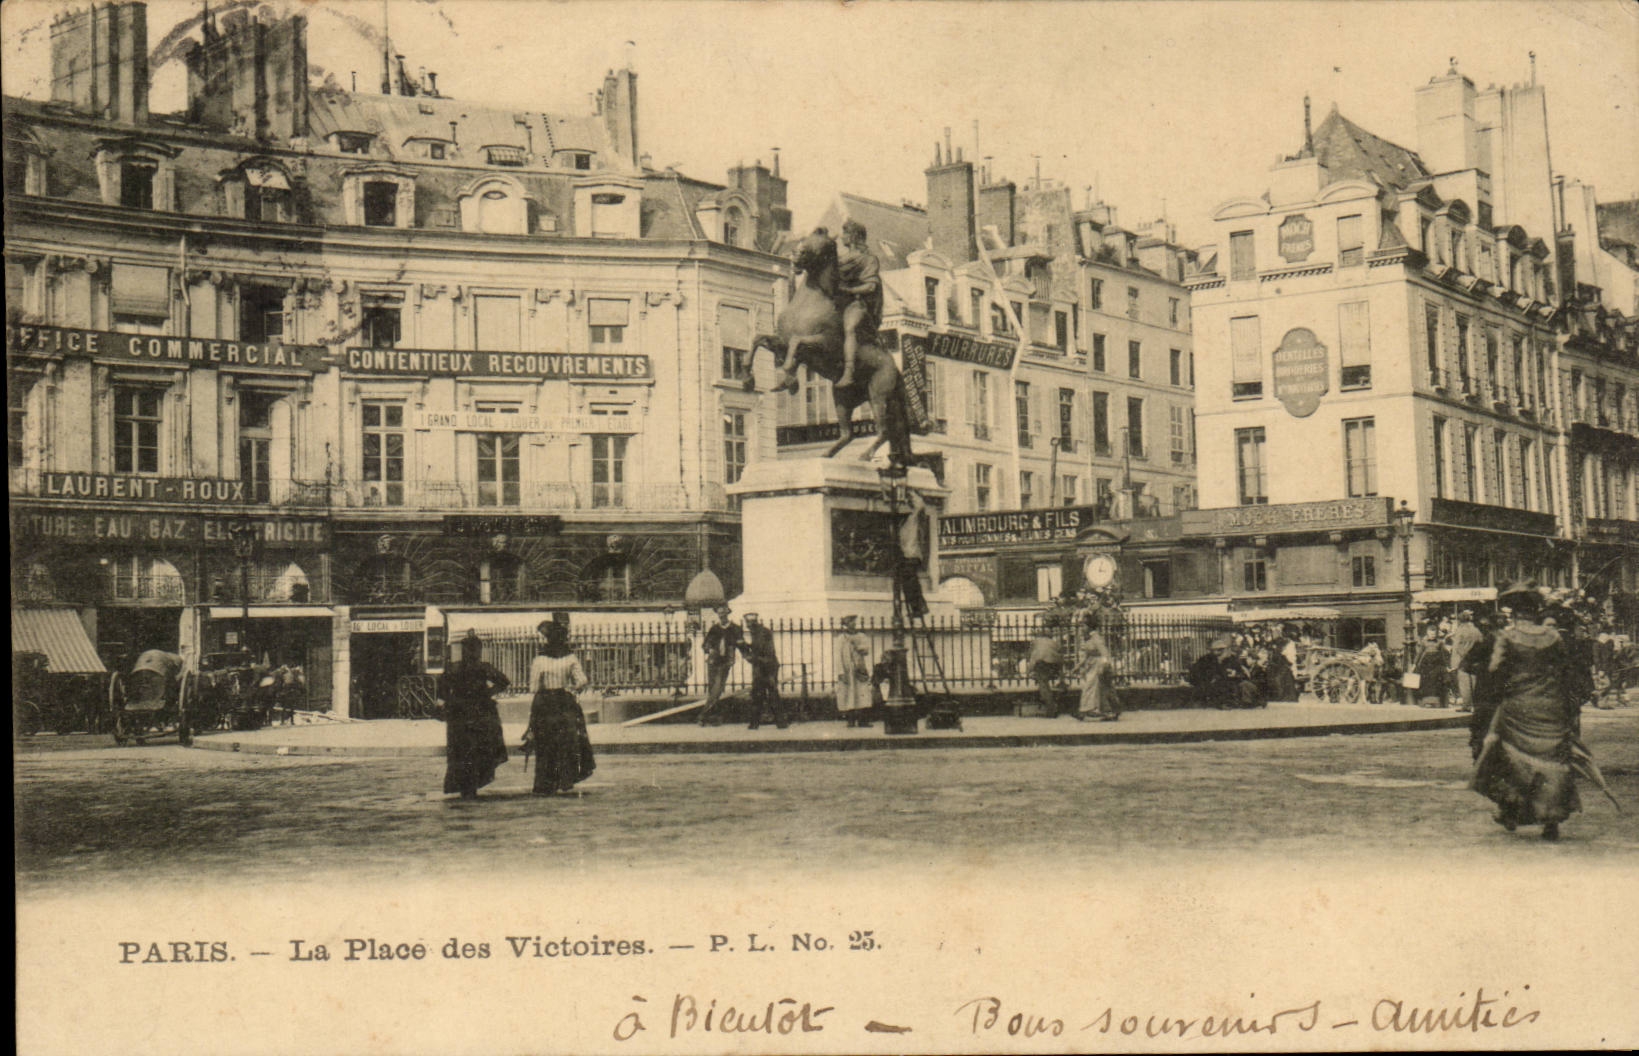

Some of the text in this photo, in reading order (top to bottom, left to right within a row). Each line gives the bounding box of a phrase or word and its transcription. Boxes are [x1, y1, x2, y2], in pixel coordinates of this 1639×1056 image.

[128, 337, 304, 367] COMMERCIAL
[349, 349, 473, 373] CONTENTIEUX
[488, 353, 647, 377] RECOUVREMENTS
[931, 334, 1013, 367] FOURRURES
[427, 413, 457, 427] GRAND
[466, 414, 493, 428] LOCAL
[94, 516, 132, 538] EAU
[149, 518, 186, 540] GAZ
[204, 520, 324, 542] ELETRICITE
[1032, 515, 1042, 529] &
[1045, 510, 1080, 528] FILS
